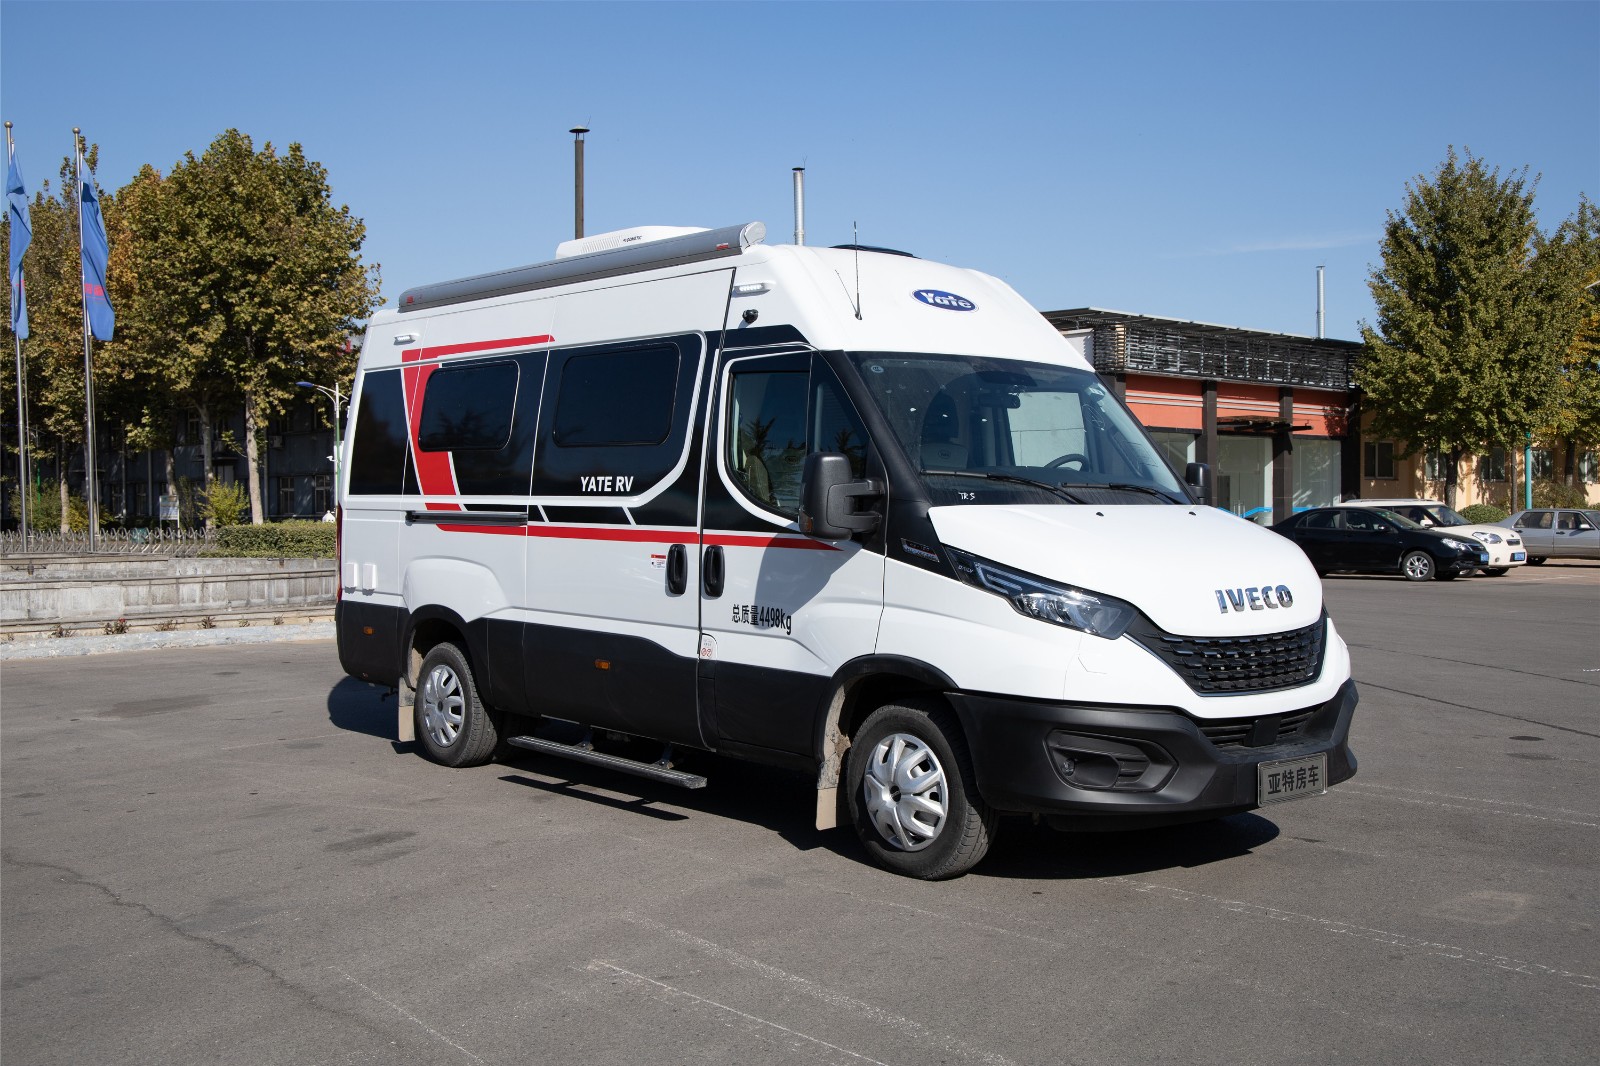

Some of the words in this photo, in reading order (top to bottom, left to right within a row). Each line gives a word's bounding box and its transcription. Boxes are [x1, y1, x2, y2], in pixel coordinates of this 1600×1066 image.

[920, 291, 972, 309] Yate
[580, 476, 612, 492] YATE
[615, 476, 634, 492] RV
[1214, 584, 1294, 614] IVECO
[1267, 764, 1319, 795] 亚特房车
